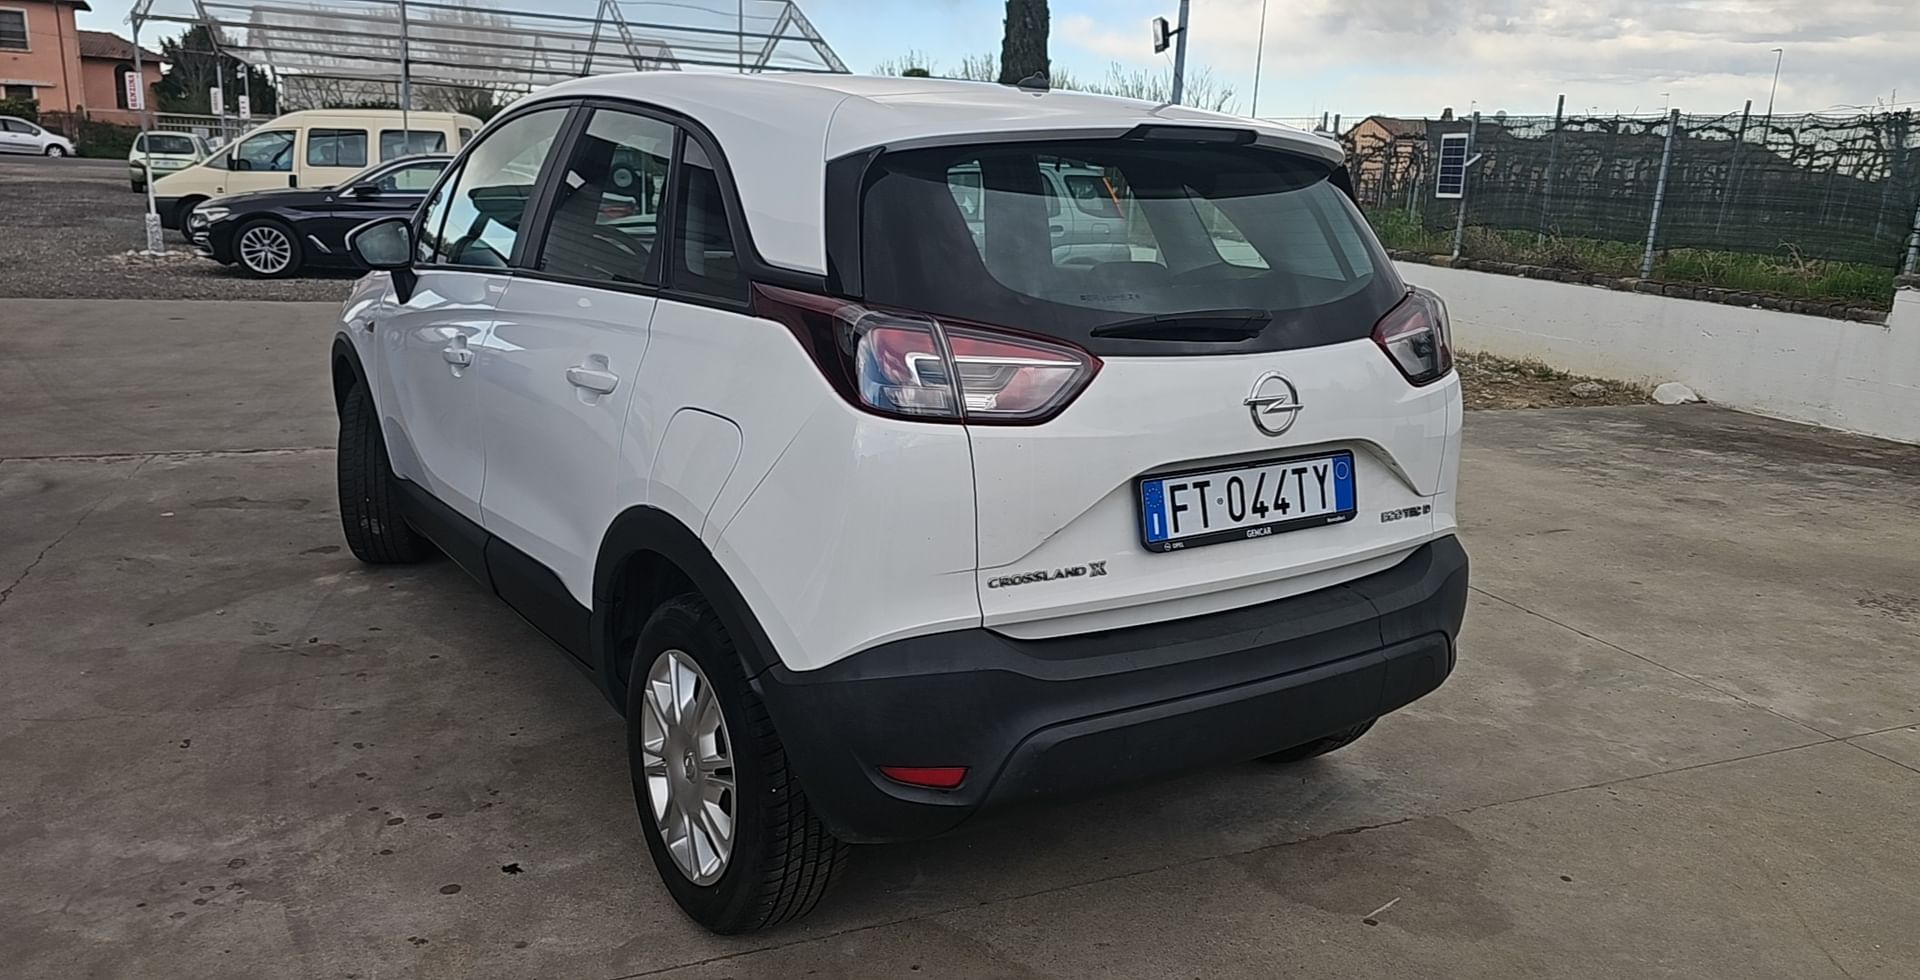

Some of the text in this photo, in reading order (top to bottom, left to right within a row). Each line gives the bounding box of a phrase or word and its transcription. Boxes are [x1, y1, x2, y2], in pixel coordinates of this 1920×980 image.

[127, 74, 138, 108] BENZINA
[1169, 464, 1328, 533] FT 044TY
[1246, 526, 1273, 538] GENCAR
[987, 560, 1108, 589] CROSSLAND X
